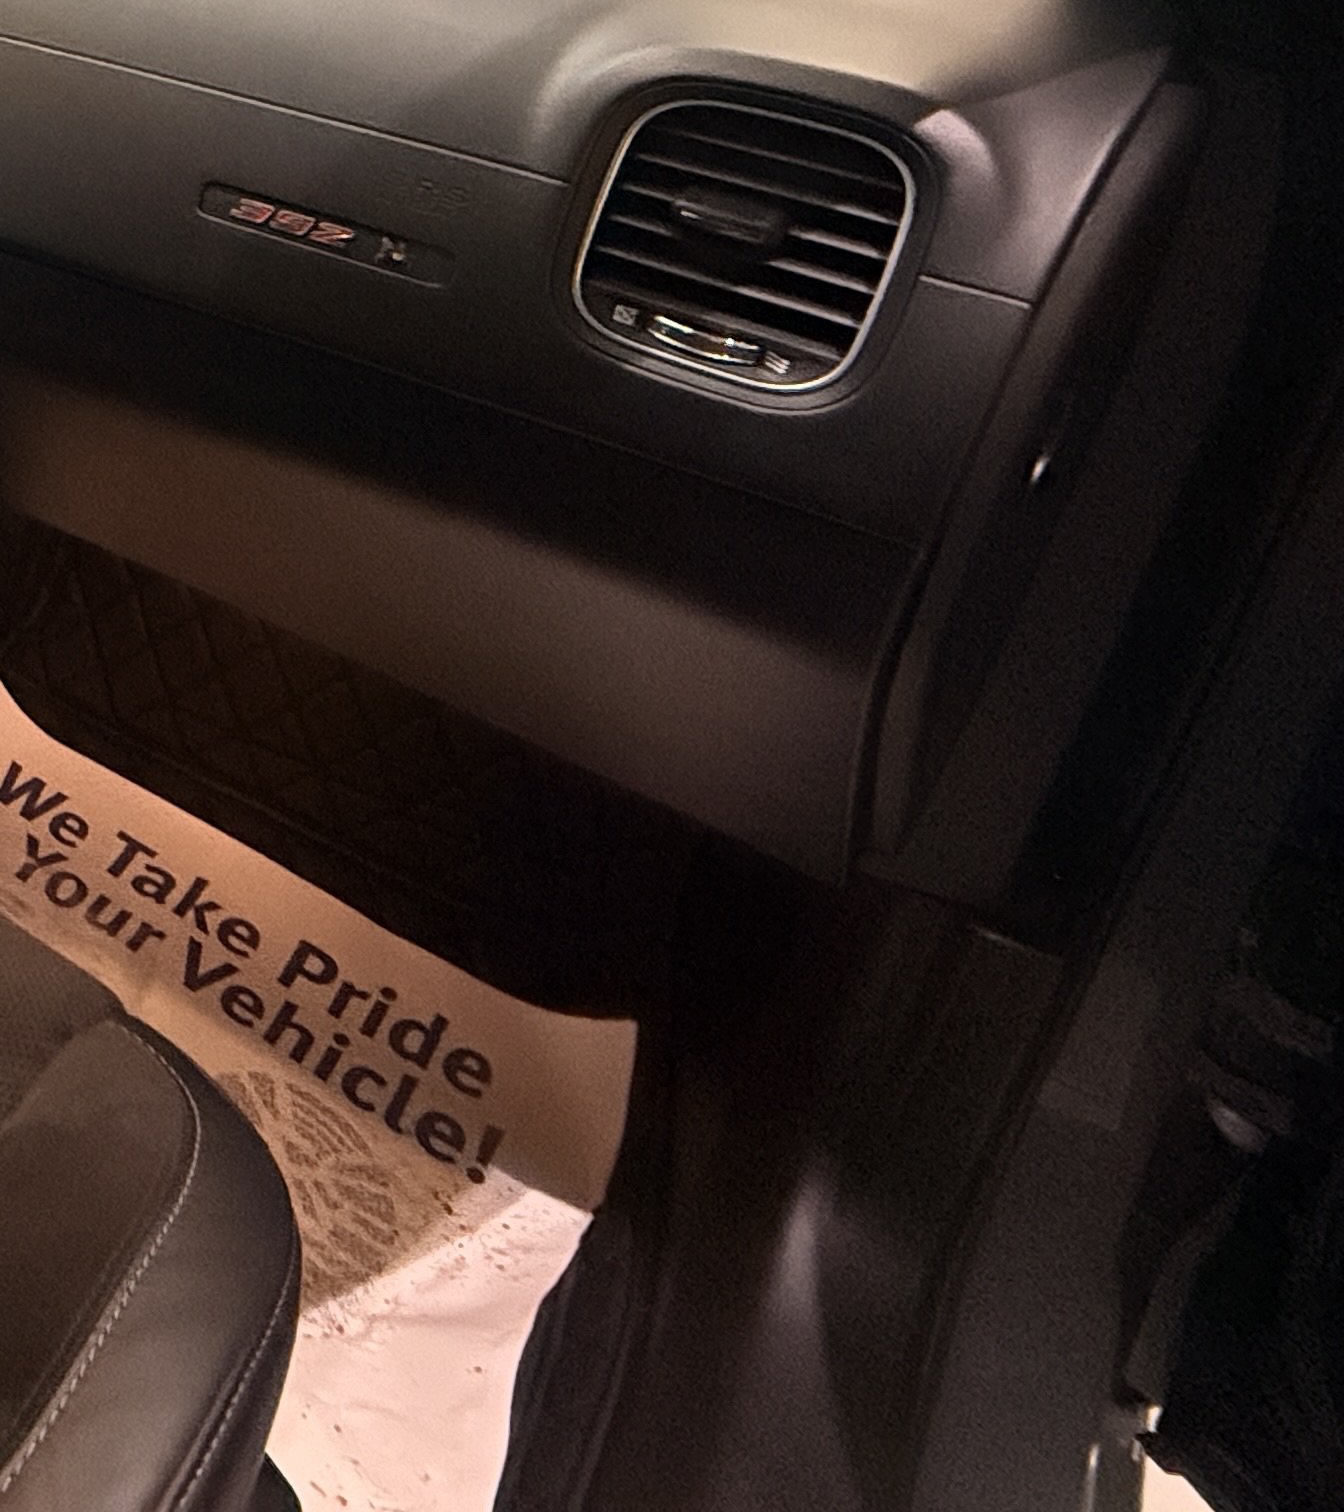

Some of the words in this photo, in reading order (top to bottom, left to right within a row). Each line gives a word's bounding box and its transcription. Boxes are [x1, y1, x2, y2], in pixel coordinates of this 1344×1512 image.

[229, 197, 357, 248] 392
[12, 834, 168, 954] Your
[181, 933, 507, 1186] Vehicle!
[106, 831, 261, 958] Take
[277, 938, 494, 1101] Pride
